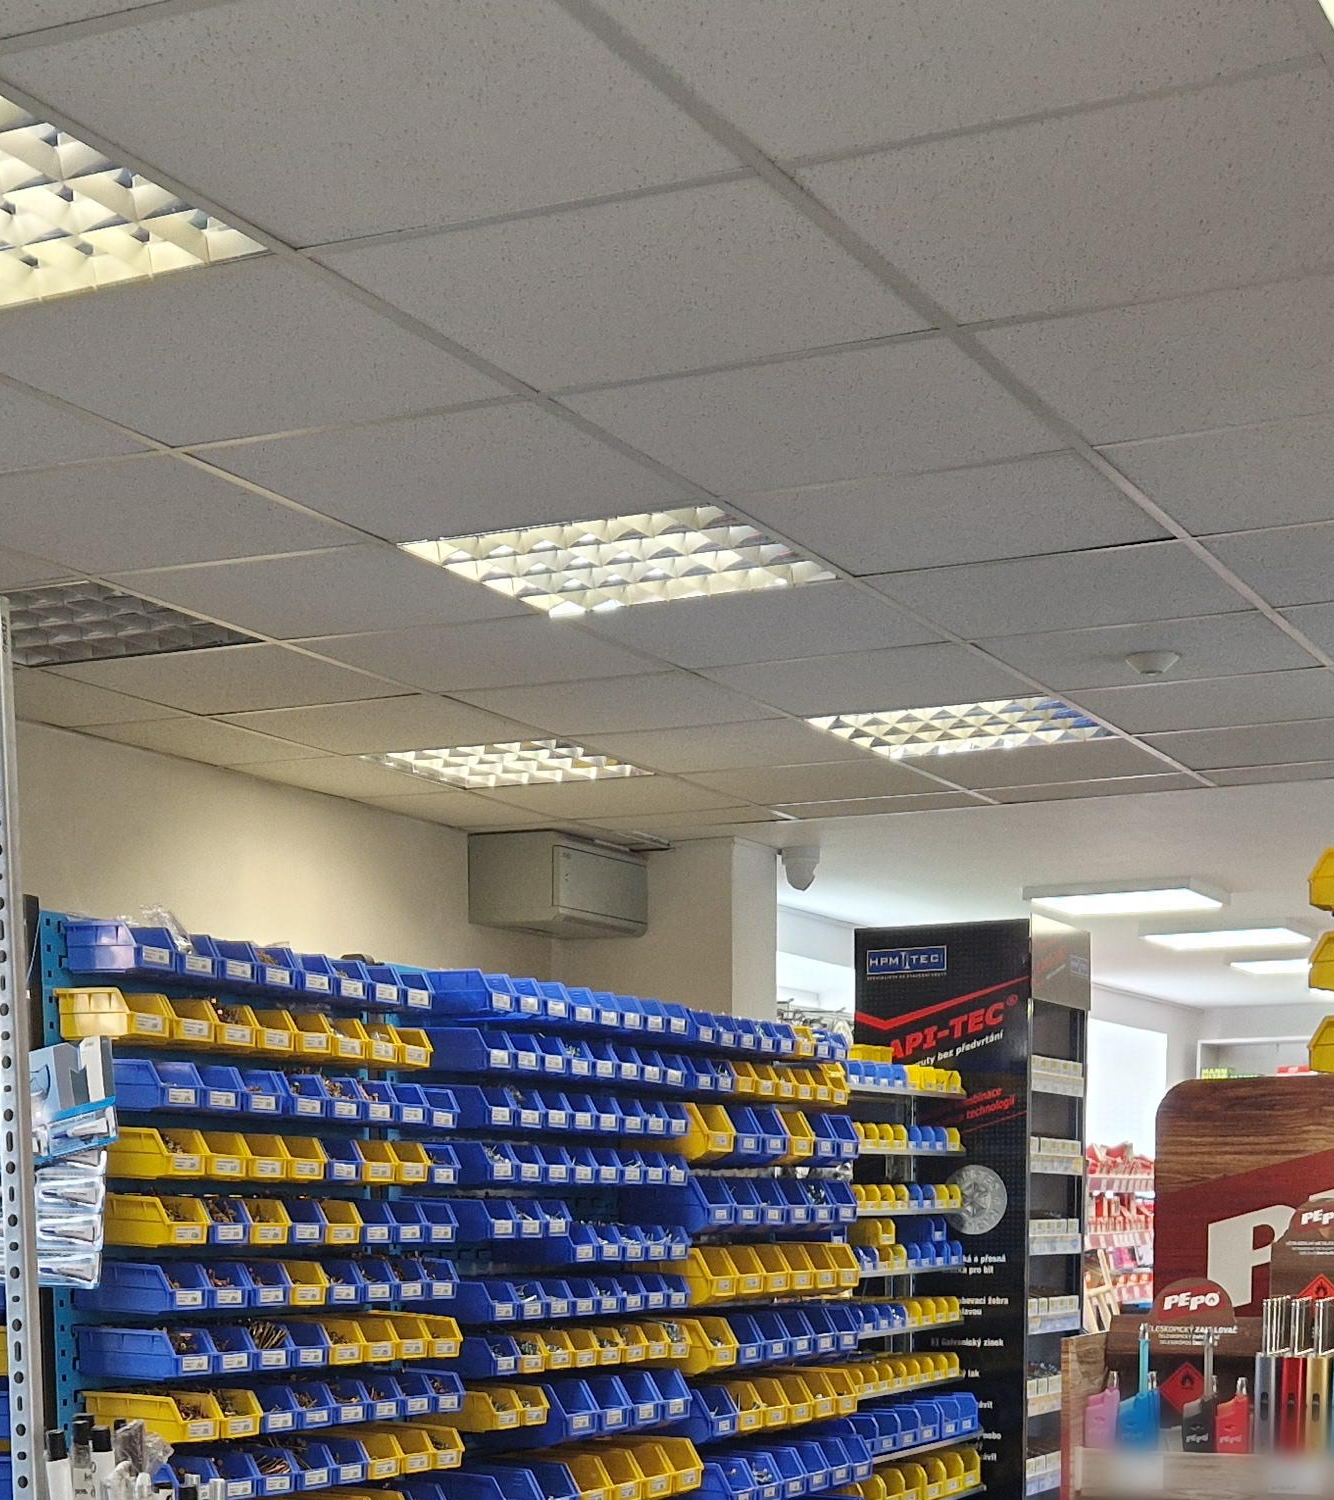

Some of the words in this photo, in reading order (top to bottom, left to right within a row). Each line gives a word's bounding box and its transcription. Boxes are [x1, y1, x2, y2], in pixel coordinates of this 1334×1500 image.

[869, 954, 899, 966] HPM
[910, 953, 940, 964] TEC
[937, 1049, 954, 1060] bez
[1163, 1291, 1220, 1311] PEPO
